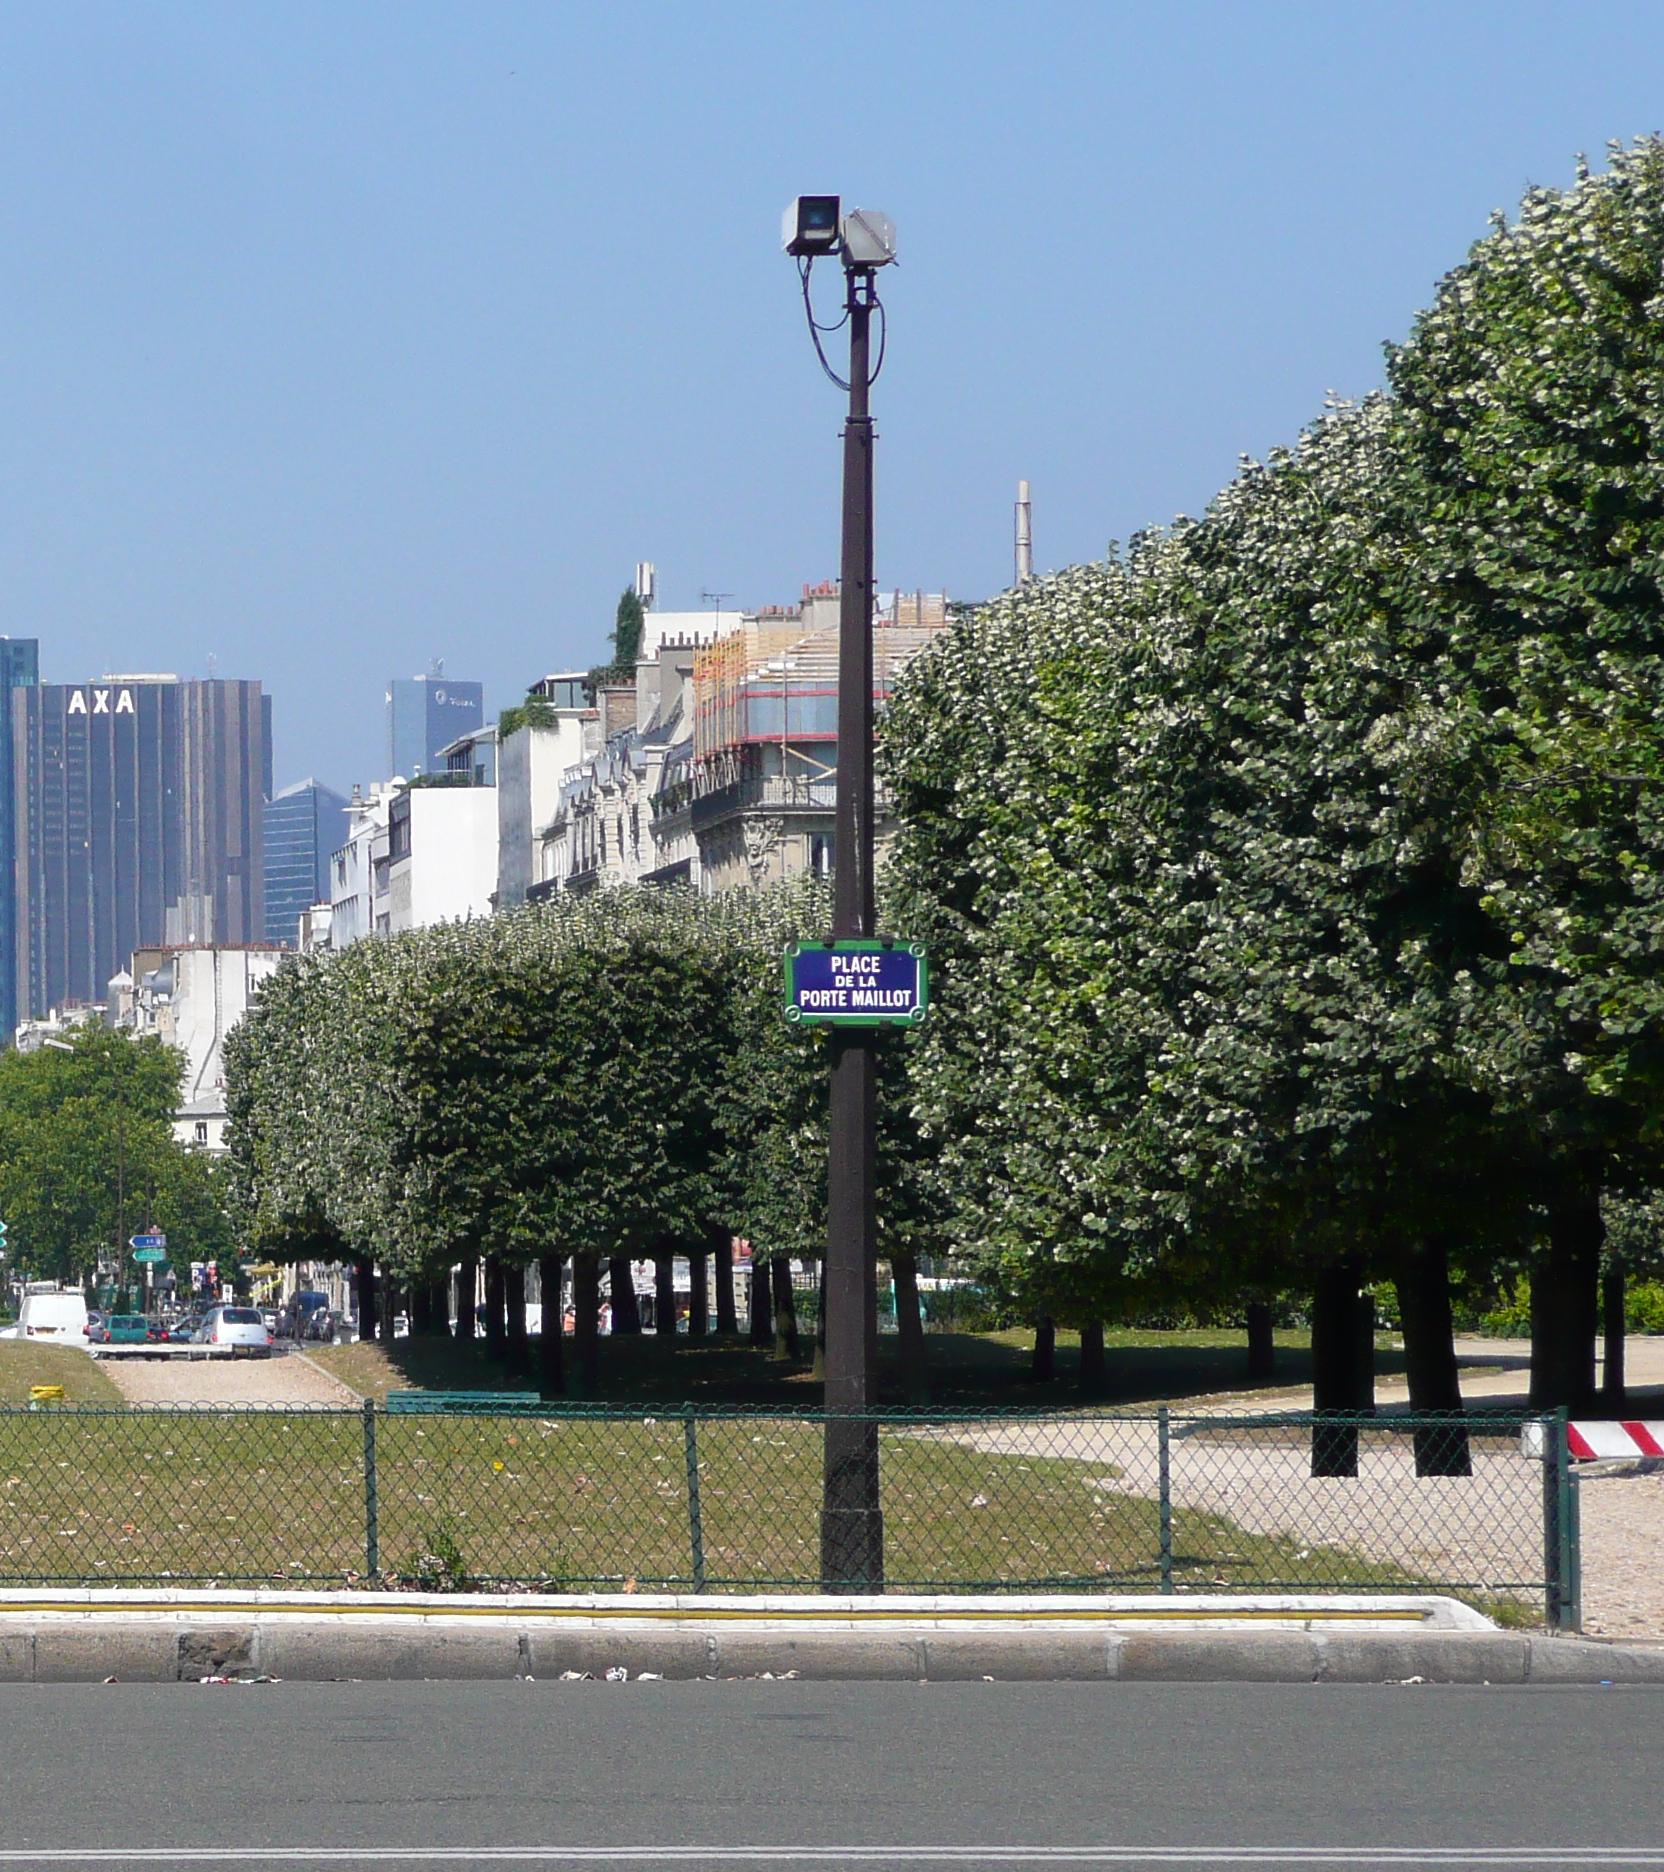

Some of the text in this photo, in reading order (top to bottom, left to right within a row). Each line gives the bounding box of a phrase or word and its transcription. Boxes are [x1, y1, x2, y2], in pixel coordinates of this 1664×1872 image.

[67, 689, 135, 714] AXA
[831, 956, 881, 973] PLACE
[835, 975, 877, 988] DE LA
[800, 990, 912, 1007] PORTE MAILLOT
